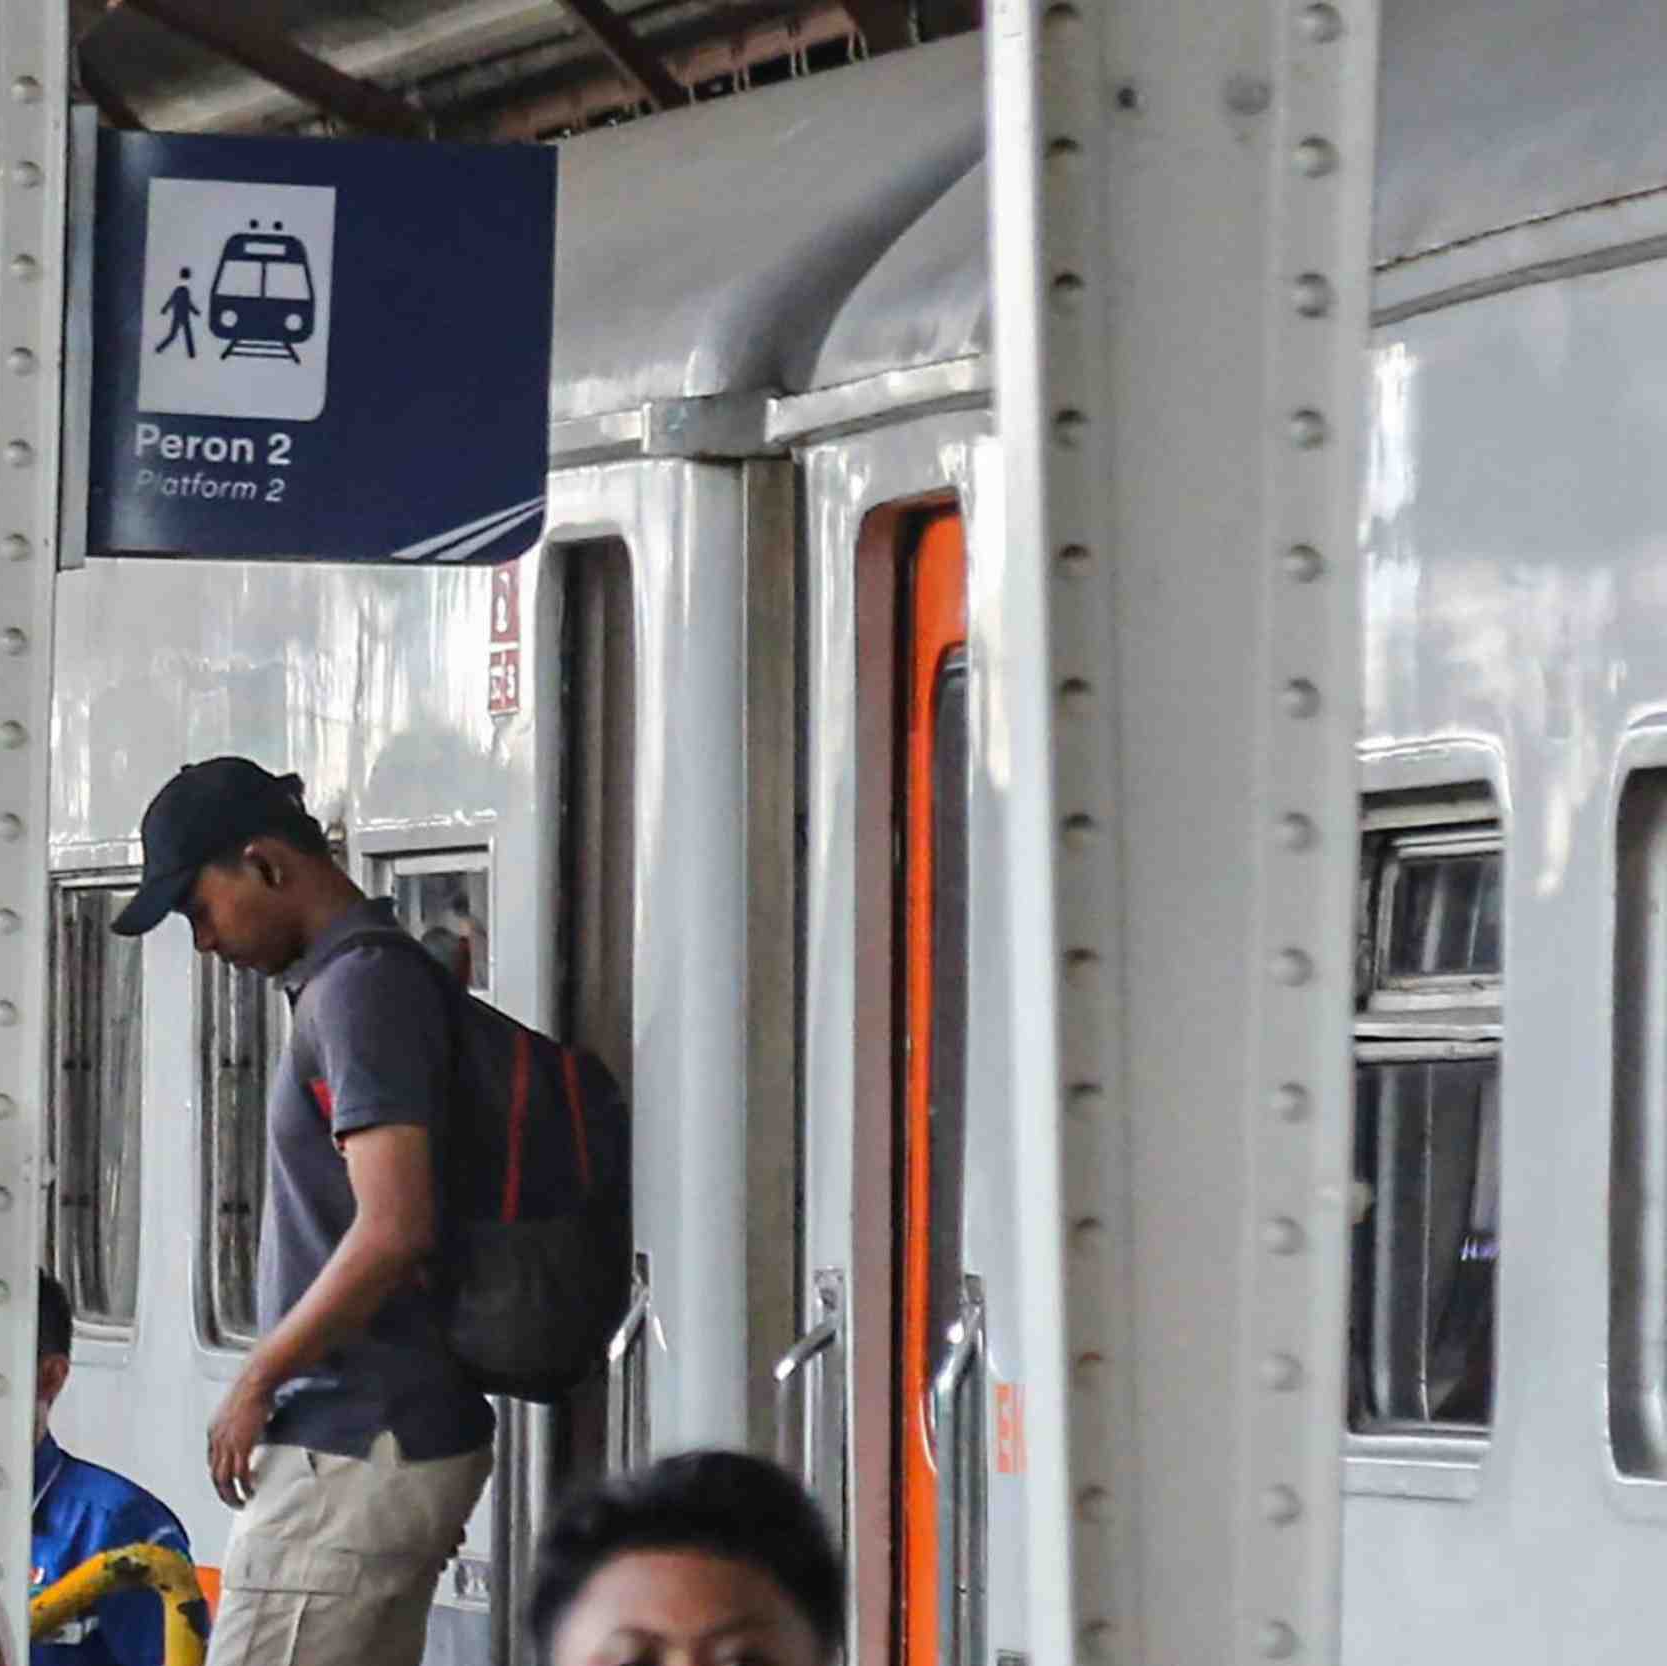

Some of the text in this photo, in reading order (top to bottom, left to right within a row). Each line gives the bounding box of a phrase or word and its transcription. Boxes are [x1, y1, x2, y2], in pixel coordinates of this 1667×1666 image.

[134, 422, 292, 466] Peron 2
[264, 477, 286, 502] 2
